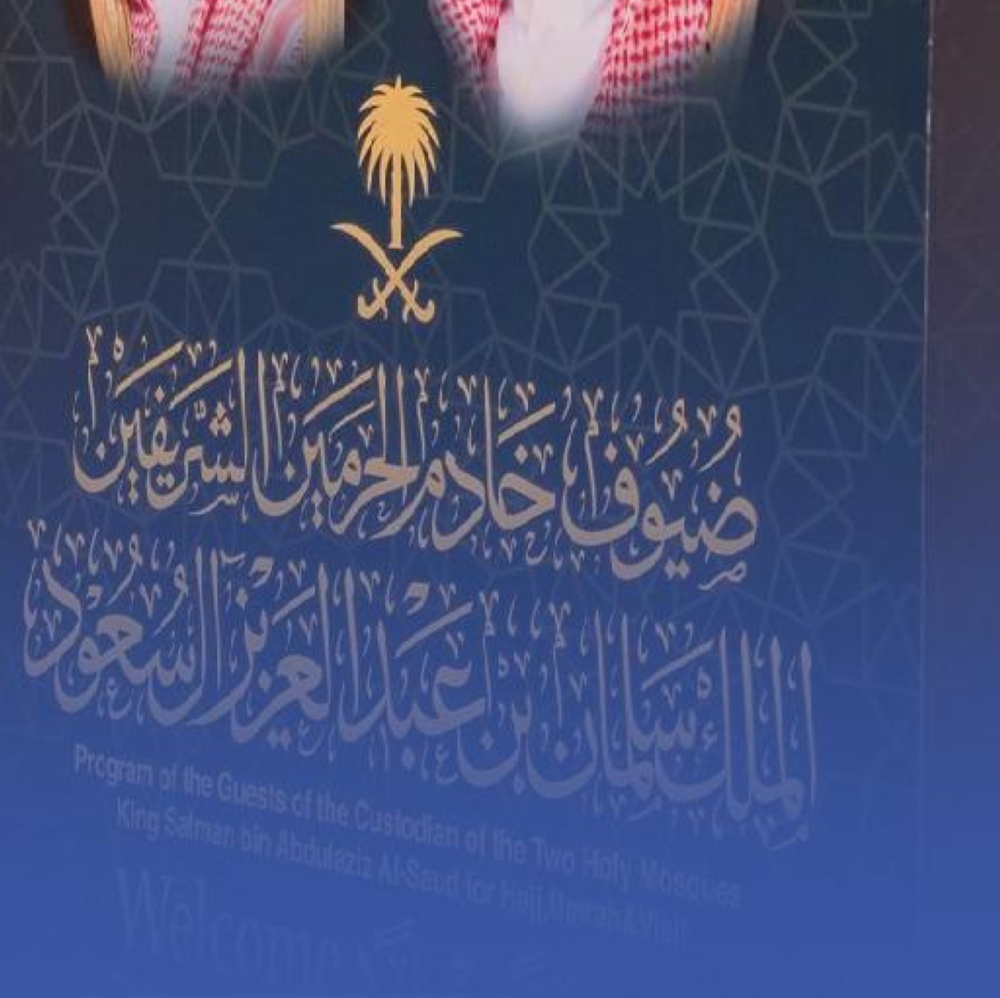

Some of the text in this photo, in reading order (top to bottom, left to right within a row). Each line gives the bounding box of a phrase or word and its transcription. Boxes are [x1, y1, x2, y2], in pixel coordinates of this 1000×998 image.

[74, 742, 744, 908] Program of the Guests of the Custodian of the Two Holy Mosques
[116, 796, 160, 842] King
[163, 806, 235, 847] Salman
[240, 823, 272, 858] bin
[274, 828, 374, 881] Abdulaziz
[376, 849, 459, 900] Al-Saud
[466, 868, 495, 904] for
